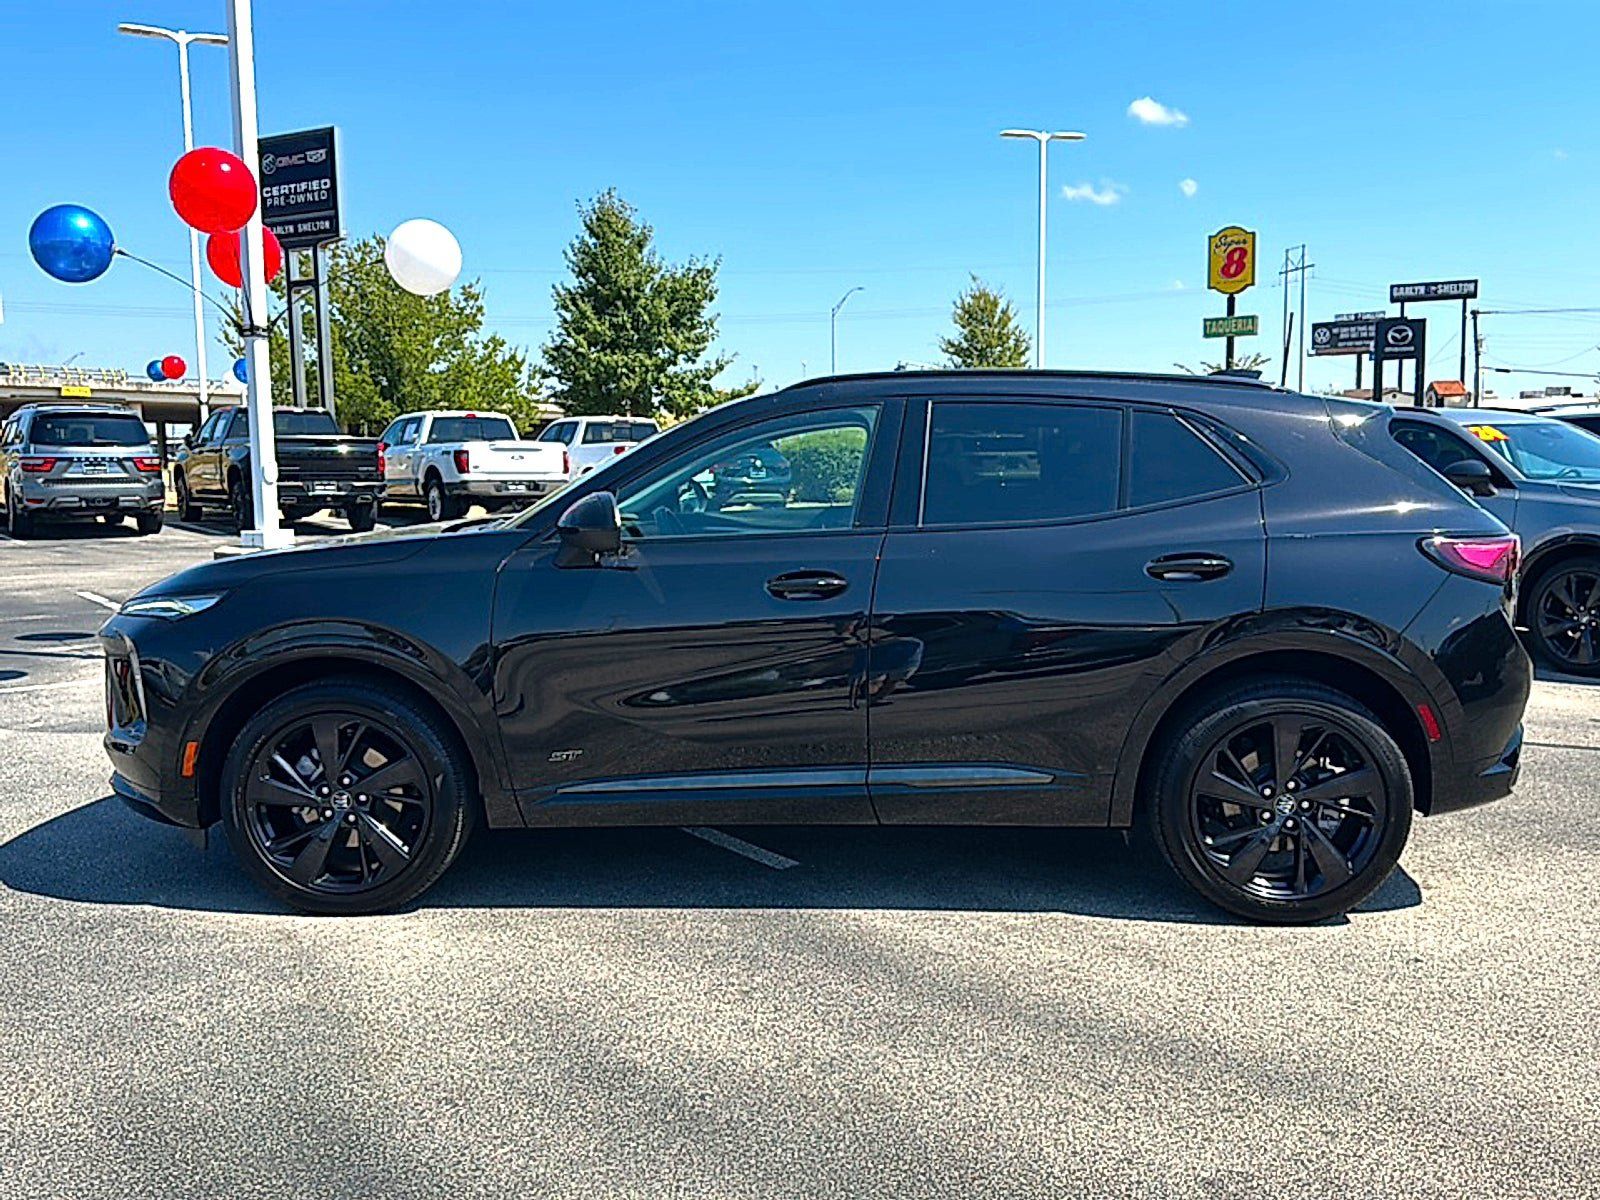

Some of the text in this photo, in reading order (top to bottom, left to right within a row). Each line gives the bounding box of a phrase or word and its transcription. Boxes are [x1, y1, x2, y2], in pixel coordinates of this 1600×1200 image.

[276, 154, 306, 168] GMC
[262, 178, 331, 198] CERTIFIED
[266, 190, 328, 207] PRE-OWNED
[298, 220, 331, 233] SHELTON
[1214, 235, 1248, 253] Super
[1220, 247, 1248, 279] 8
[1436, 282, 1475, 295] SHELTON
[1205, 319, 1253, 334] TAQUERIA
[548, 749, 583, 761] ST
